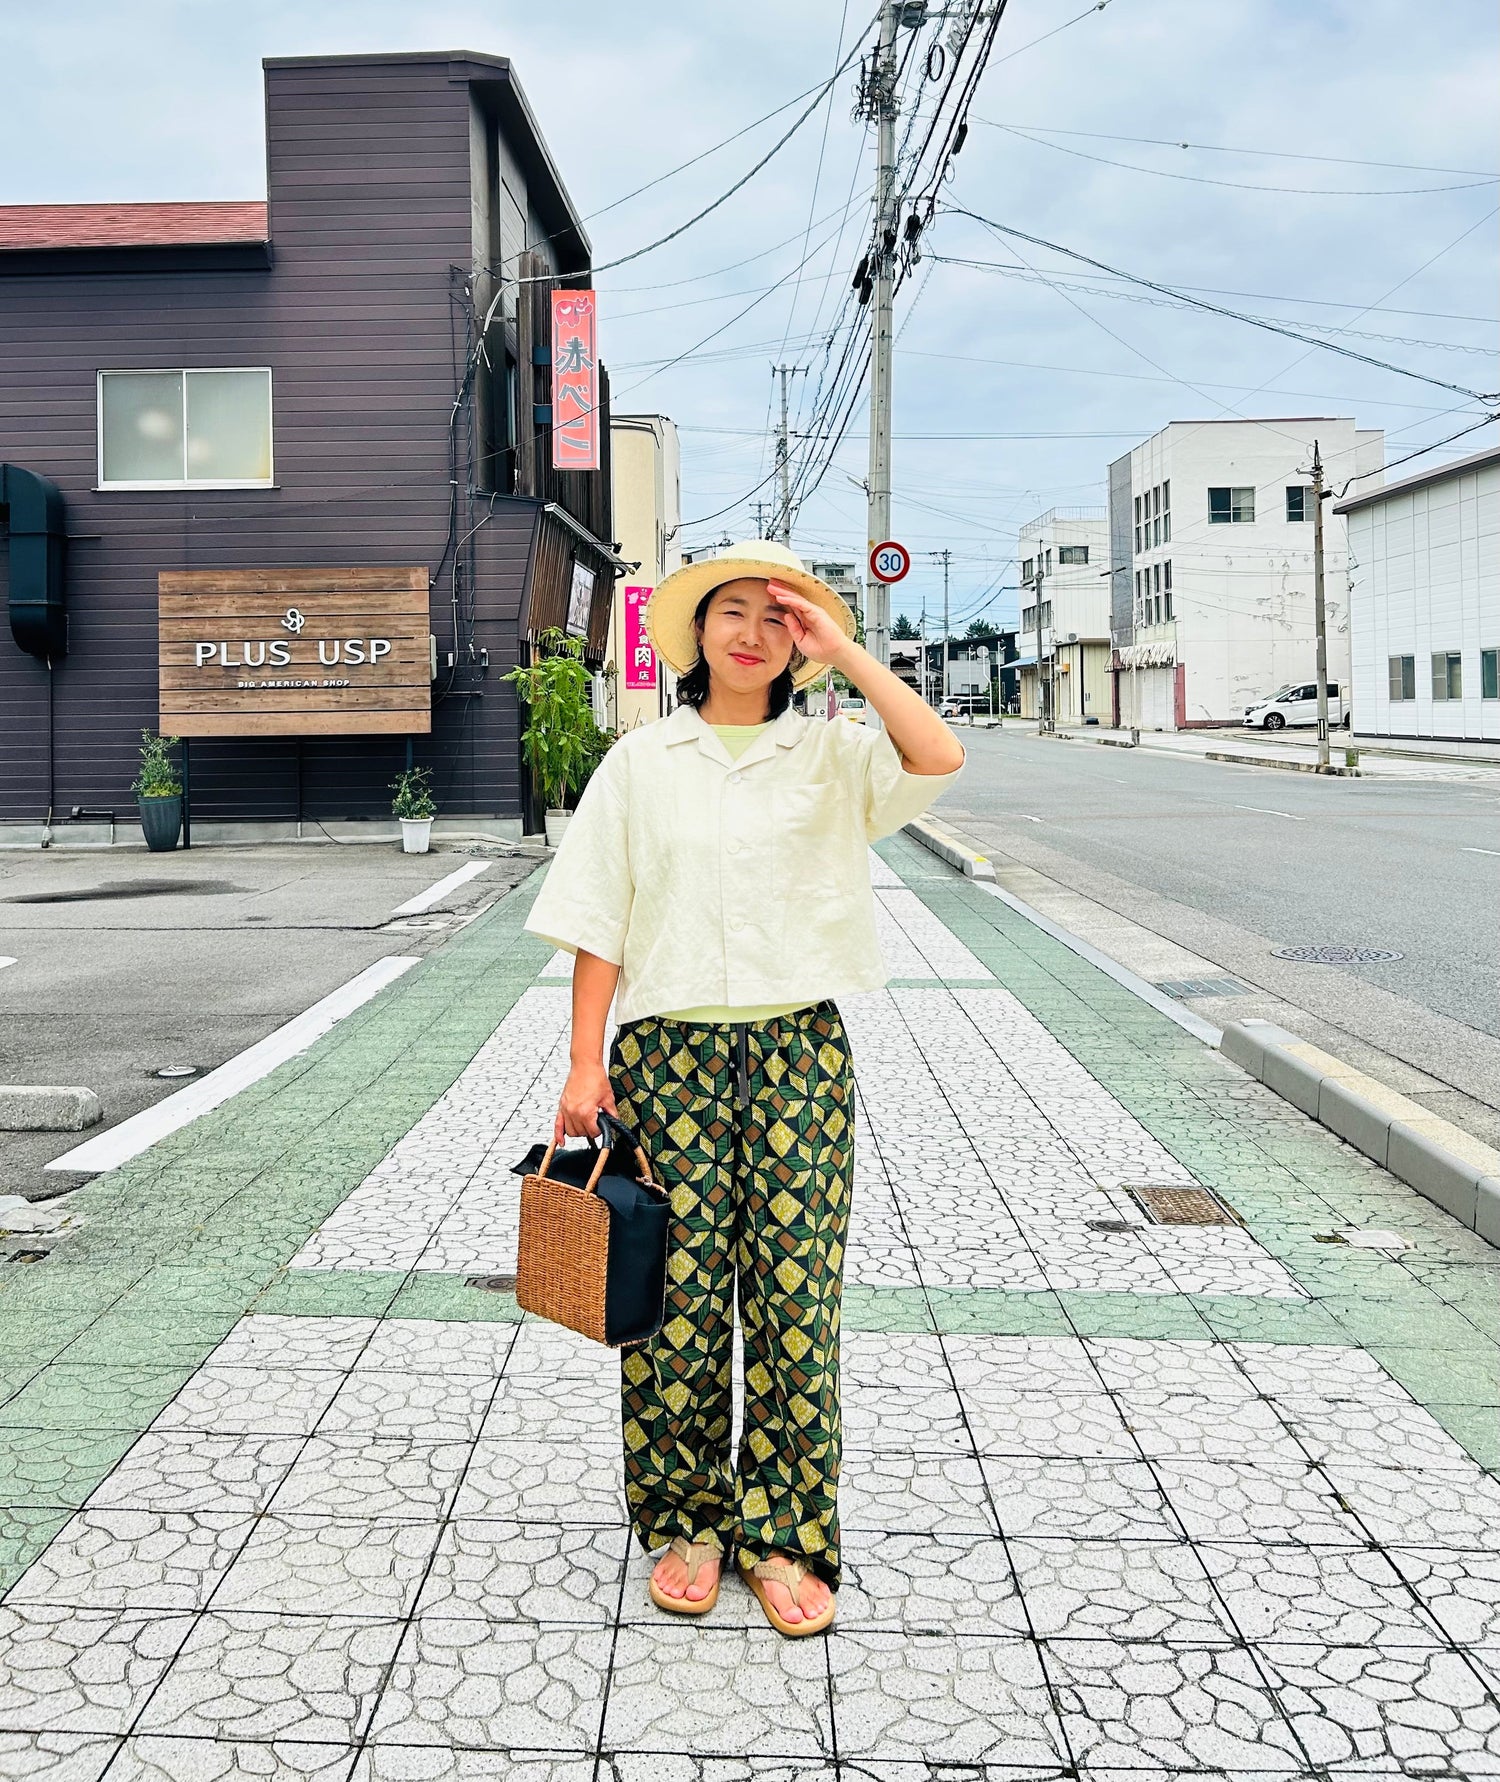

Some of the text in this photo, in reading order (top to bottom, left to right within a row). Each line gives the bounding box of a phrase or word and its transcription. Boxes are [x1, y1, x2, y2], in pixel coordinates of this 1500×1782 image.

[879, 553, 901, 571] 30
[196, 639, 391, 667] PLUS USP
[260, 680, 318, 688] AMERICAN
[322, 679, 350, 687] SHOP
